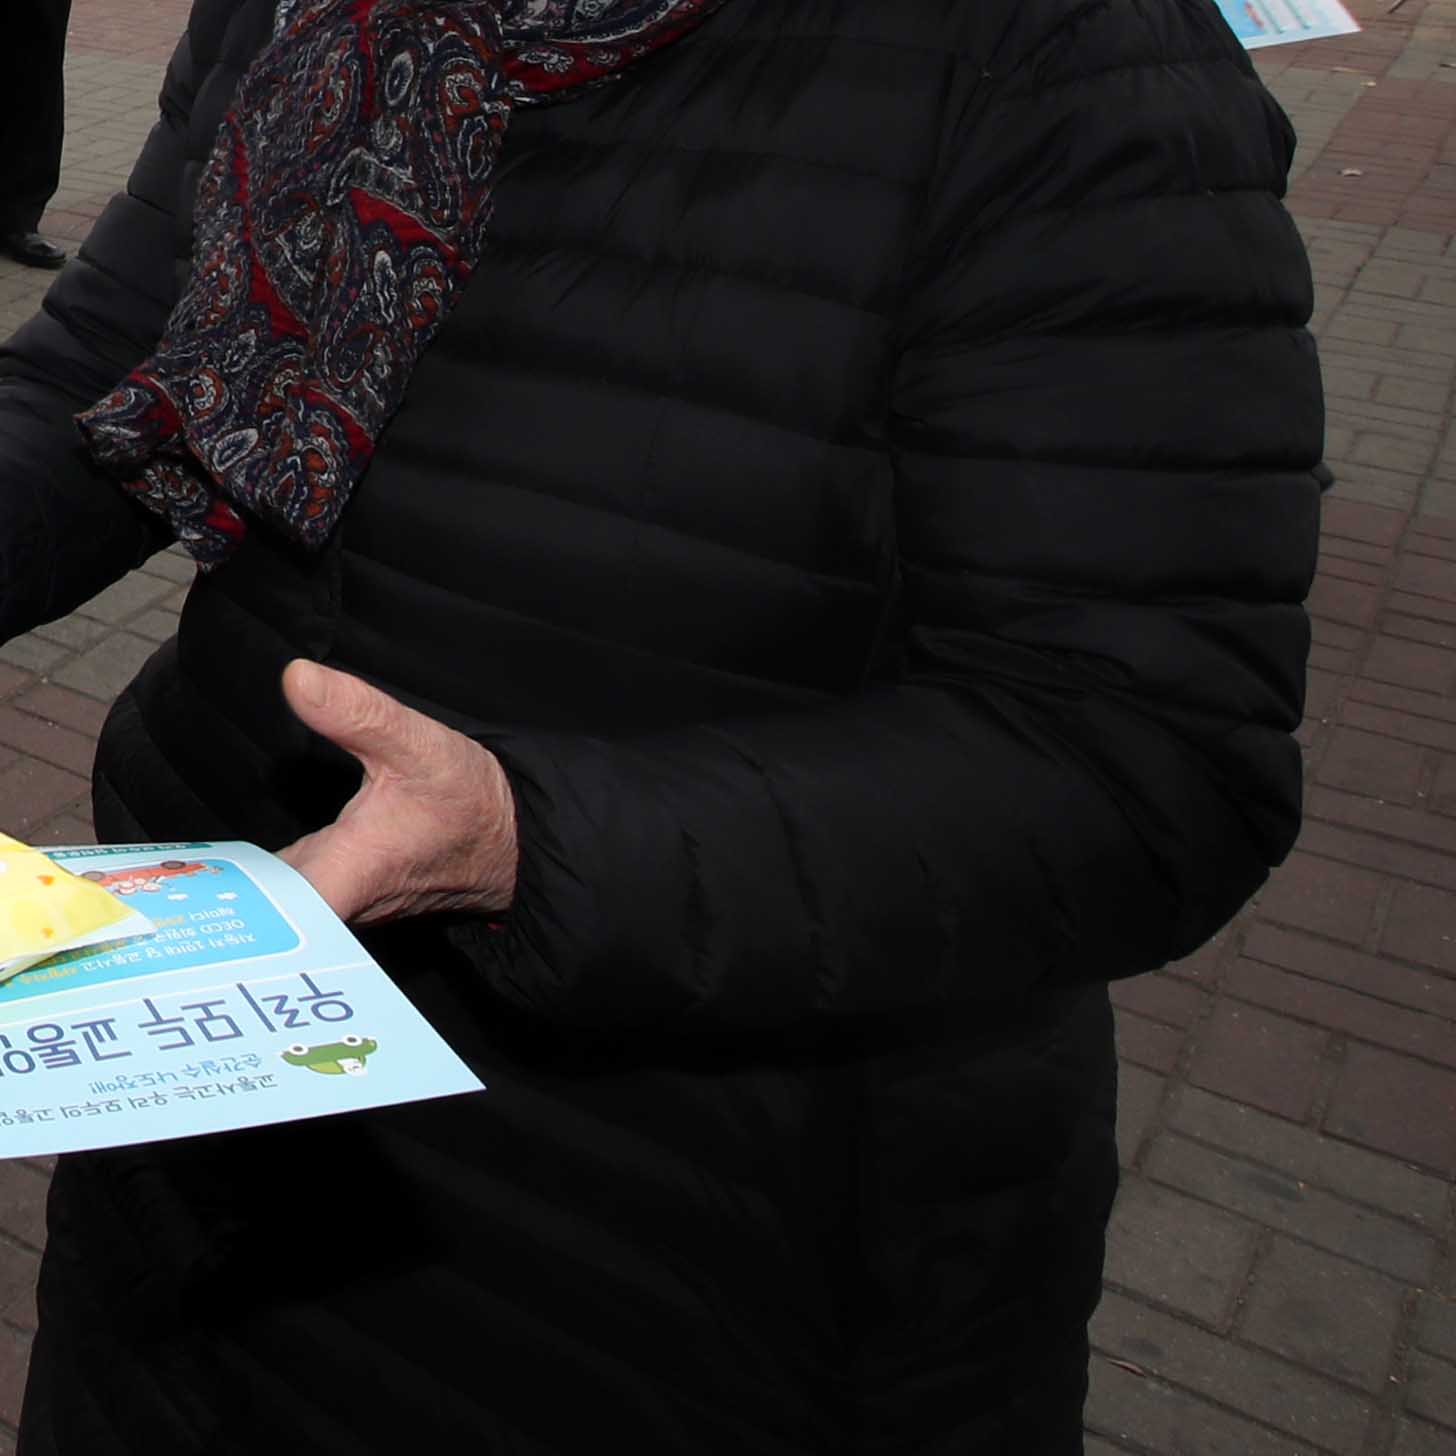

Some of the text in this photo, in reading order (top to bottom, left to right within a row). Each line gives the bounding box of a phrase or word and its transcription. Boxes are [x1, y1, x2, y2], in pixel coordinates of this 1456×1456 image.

[201, 919, 246, 935] OECD
[236, 972, 355, 1034] 우리
[137, 997, 244, 1052] 모두
[88, 1052, 264, 1095] 순간실수 나도장애!
[175, 1073, 279, 1102] 교통사고는
[58, 1096, 123, 1119] 모두의
[131, 1090, 169, 1111] 우리
